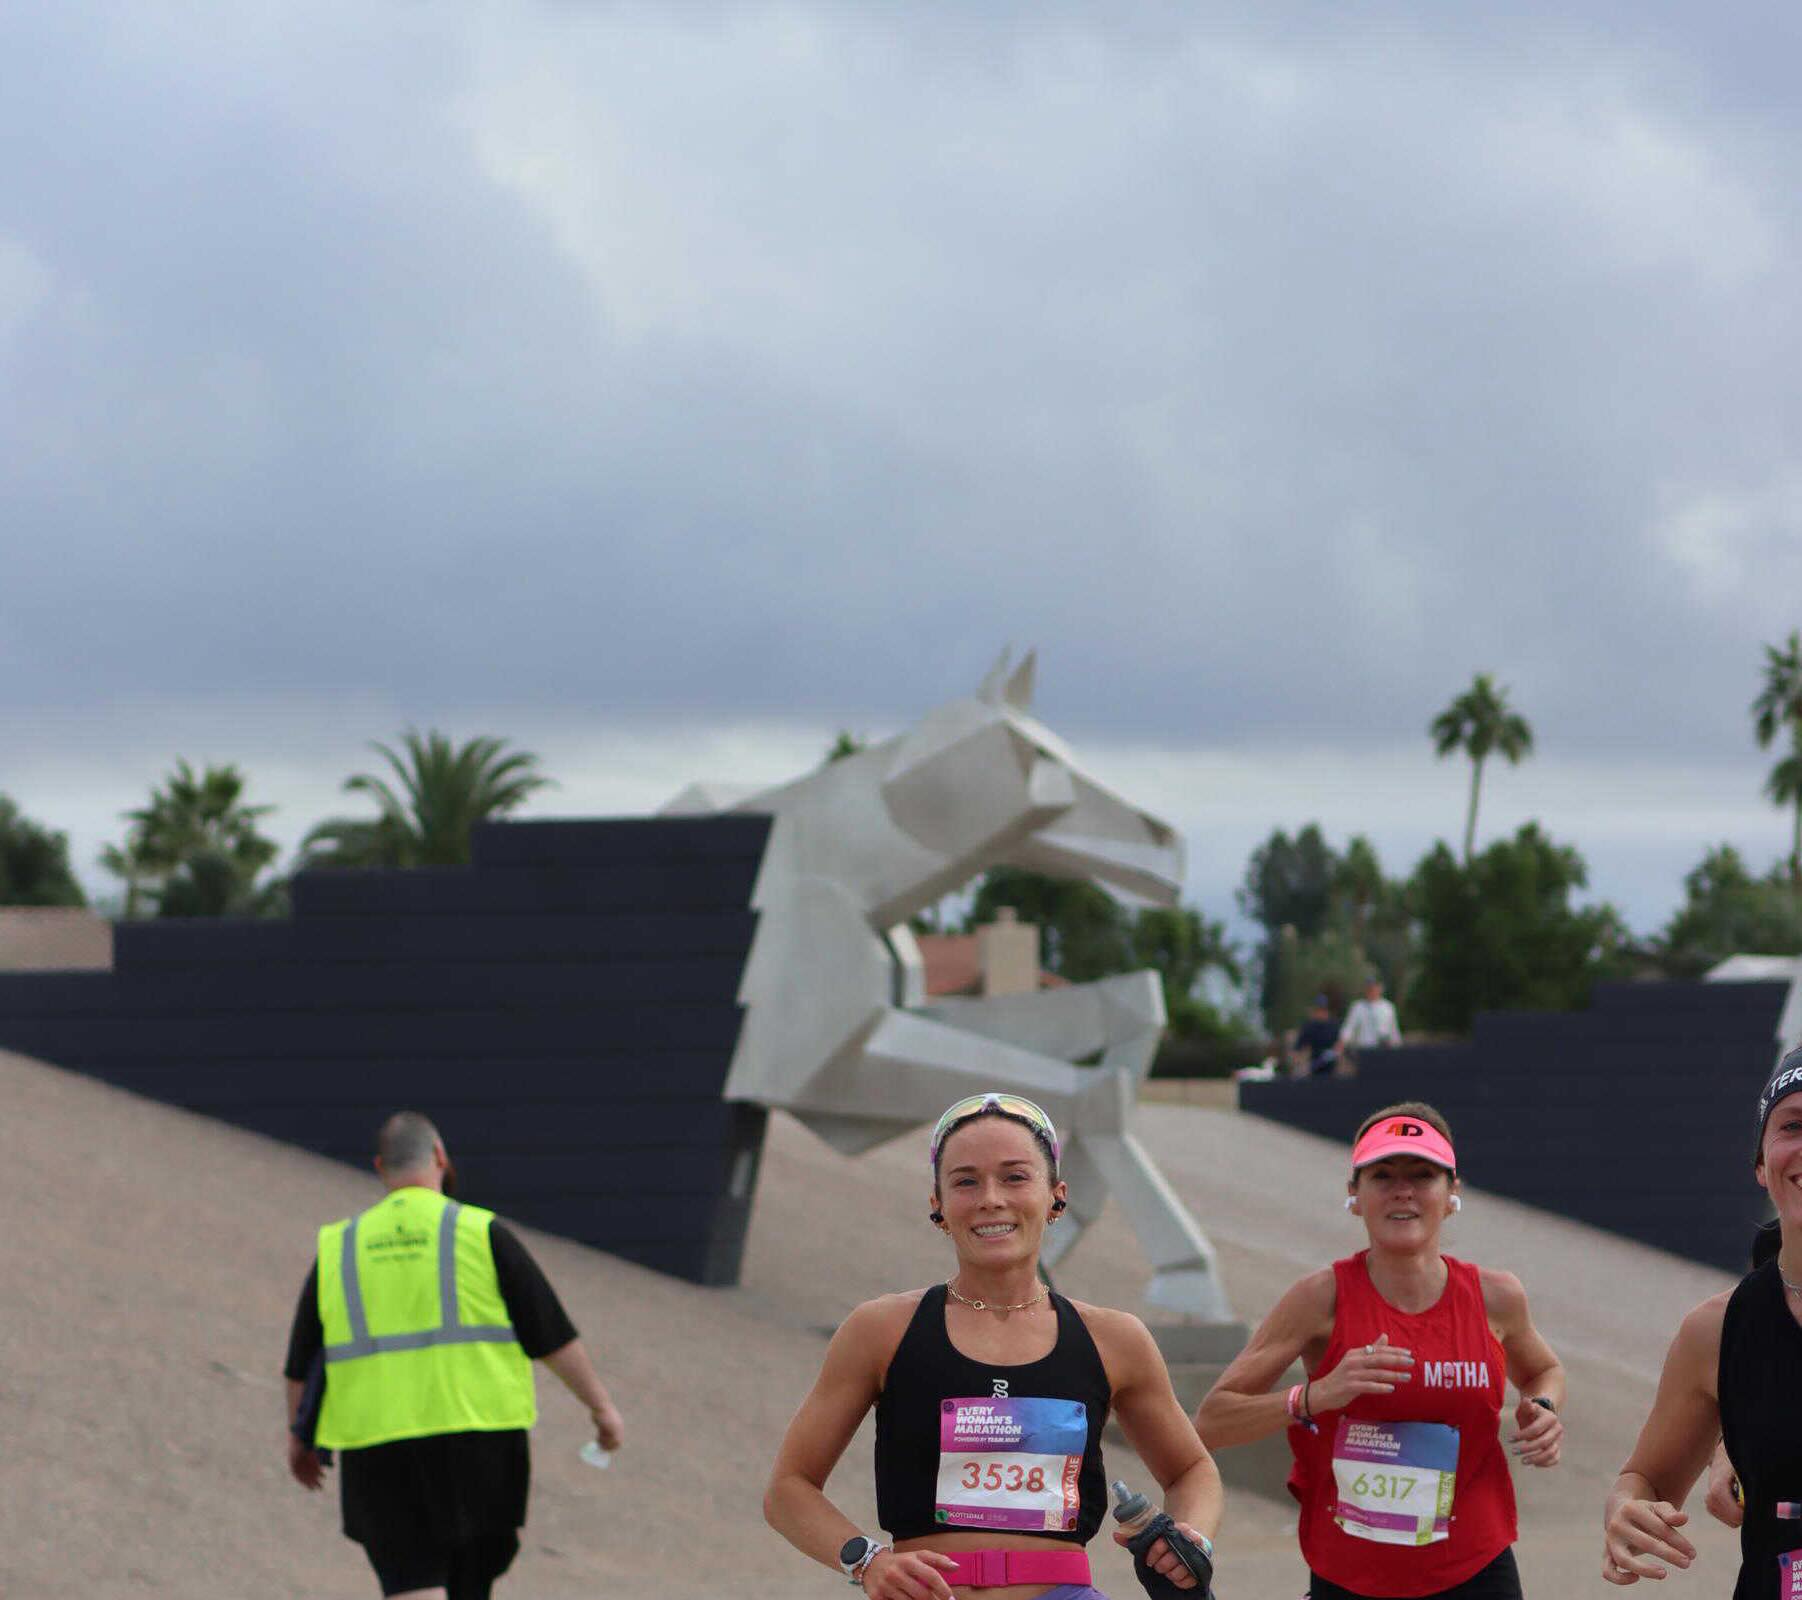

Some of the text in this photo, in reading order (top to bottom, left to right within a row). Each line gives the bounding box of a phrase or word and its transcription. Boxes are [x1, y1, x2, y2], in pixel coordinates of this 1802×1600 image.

[957, 1406, 995, 1416] EVERY
[956, 1415, 1013, 1425] WOMAN'S
[954, 1424, 1022, 1435] MARATHON
[1345, 1438, 1401, 1450] MARATHON
[961, 1462, 1044, 1493] 3538
[1067, 1455, 1080, 1509] NATALIE
[1352, 1472, 1418, 1501] 6317
